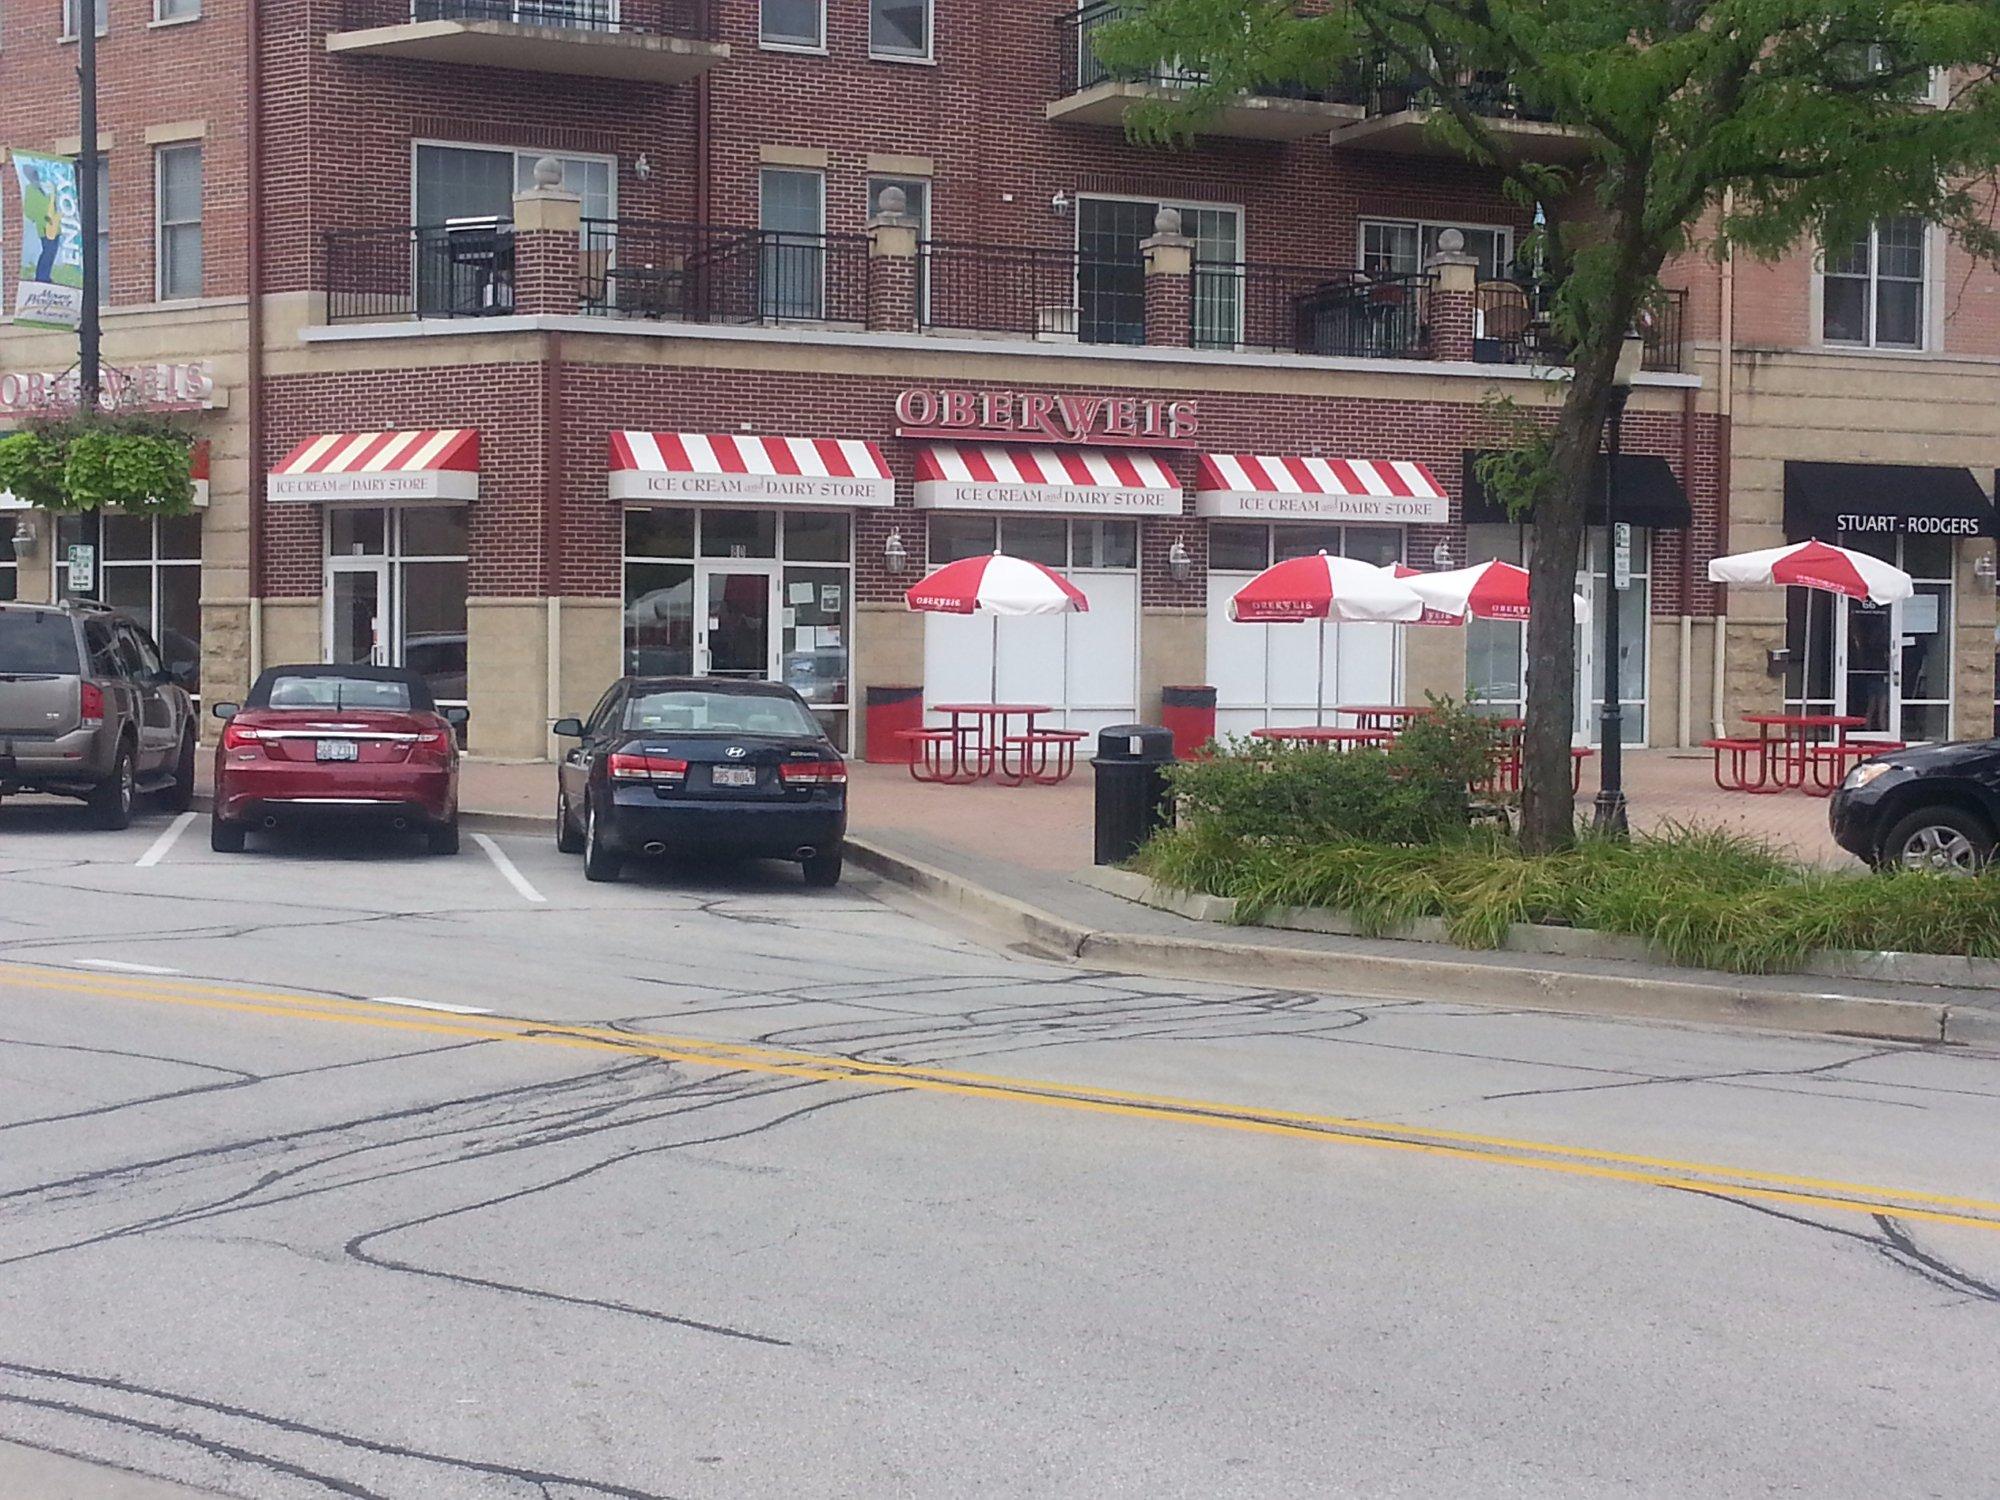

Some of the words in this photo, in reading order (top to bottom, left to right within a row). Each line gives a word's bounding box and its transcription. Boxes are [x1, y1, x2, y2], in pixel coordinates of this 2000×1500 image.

[55, 171, 81, 265] ENJOY
[0, 362, 213, 410] OBEWEIS
[895, 388, 1199, 444] OBERWEIS
[276, 480, 297, 493] ICE
[298, 479, 337, 492] CREAM
[352, 478, 387, 491] DAIRY
[389, 478, 429, 490] STORE
[649, 477, 677, 491] ICE
[682, 478, 741, 493] CREAM
[766, 482, 816, 495] DAIRY
[820, 483, 876, 498] STORE
[956, 487, 983, 501] ICE
[986, 488, 1042, 502] CREAM
[1064, 491, 1111, 504] DAIRY
[1114, 492, 1165, 506] STORE
[1239, 497, 1264, 510] ICE
[1268, 498, 1319, 511] CREAM
[1339, 500, 1381, 514] DAIRY
[1384, 502, 1432, 515] STORE
[1837, 514, 1897, 532] STUART
[1907, 516, 1979, 534] RODGERS
